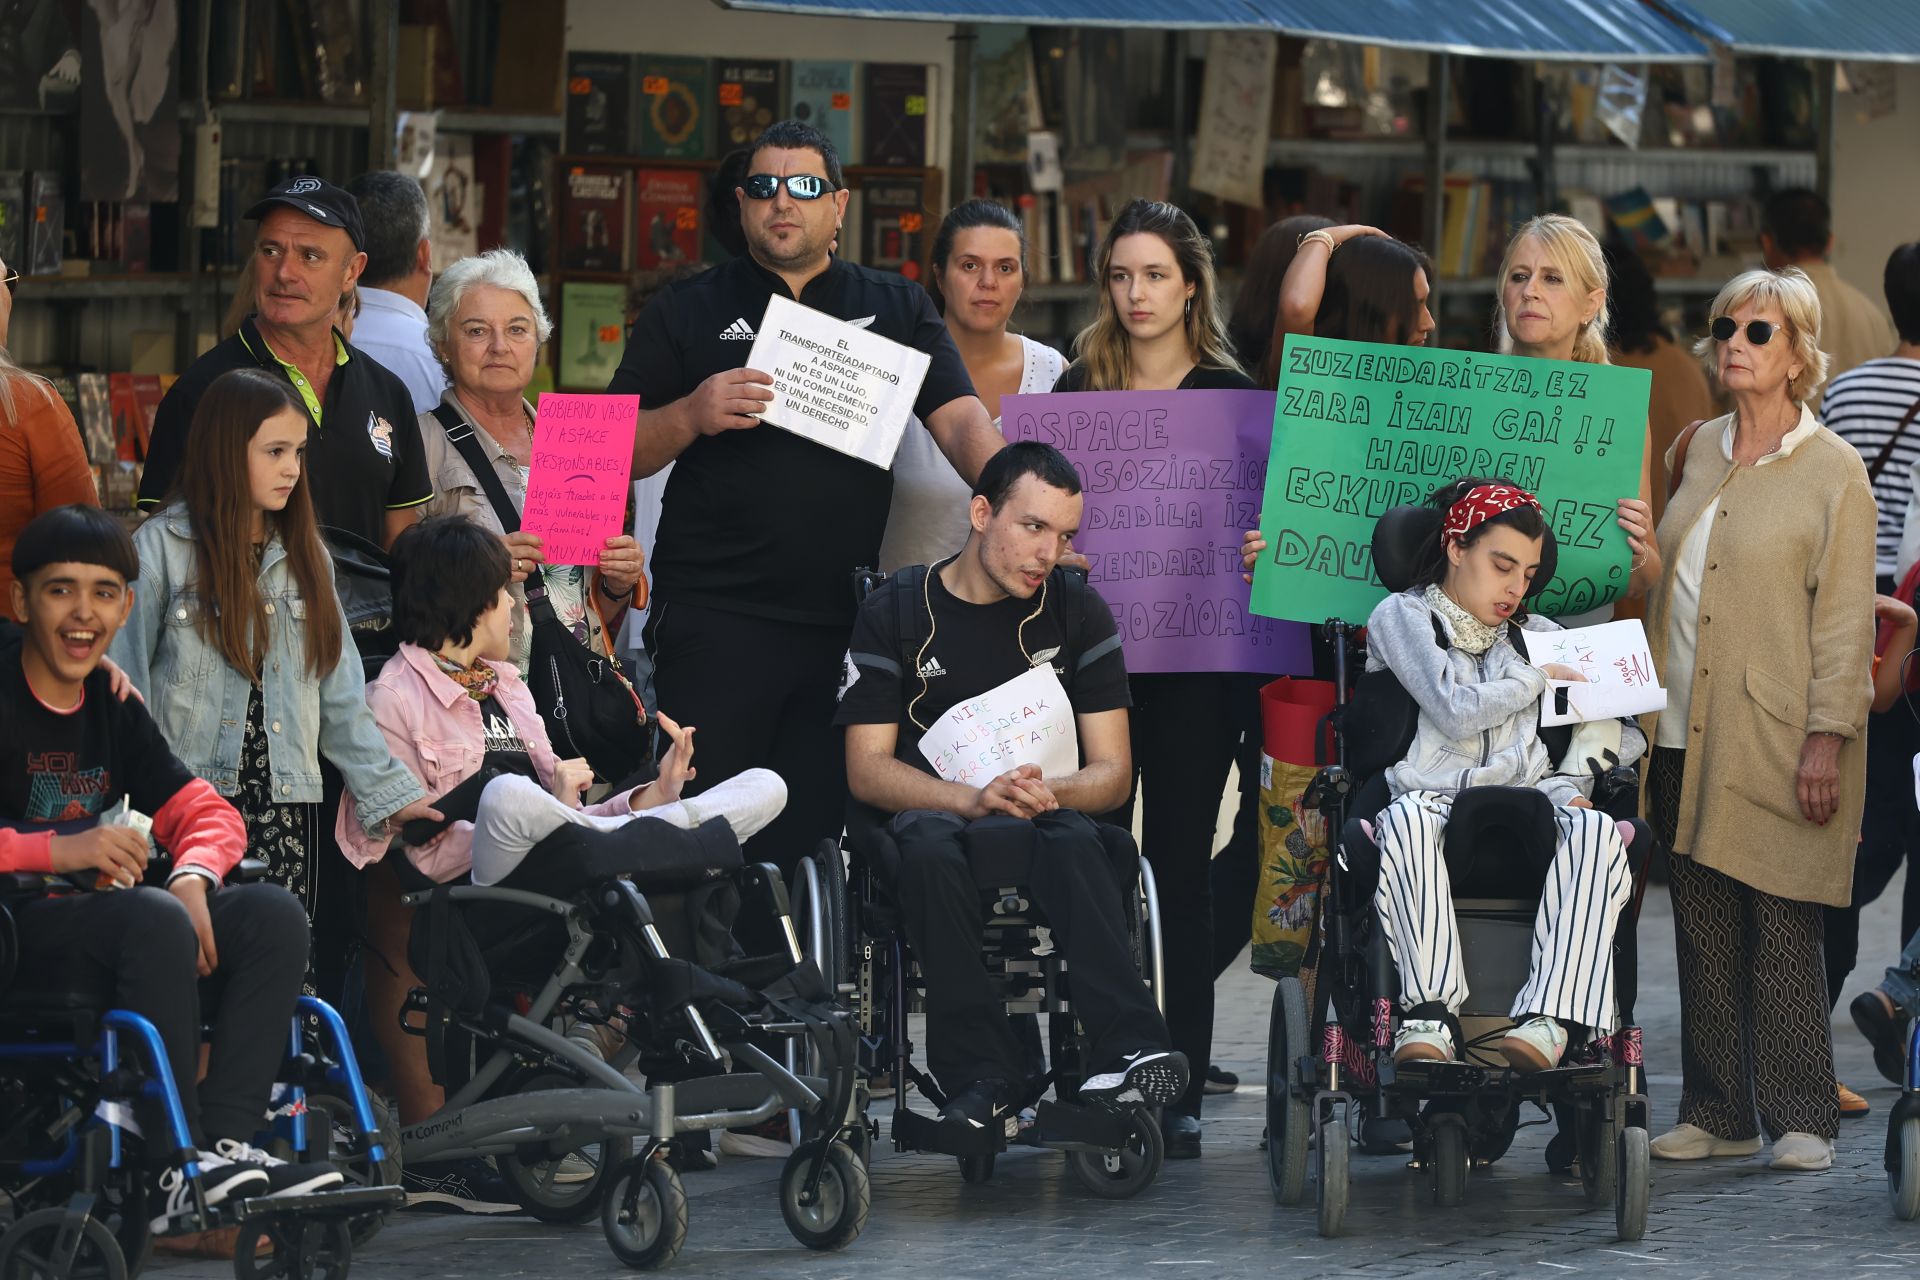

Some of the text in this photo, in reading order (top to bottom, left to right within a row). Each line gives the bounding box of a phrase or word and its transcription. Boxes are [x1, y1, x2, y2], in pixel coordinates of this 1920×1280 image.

[837, 339, 850, 351] EL
[792, 361, 867, 399] NO ES UN LUJO,
[811, 356, 859, 381] A ASPACE
[774, 367, 878, 415] NI UN COMPLEMENTO
[774, 381, 869, 427] ES UNA NECESIDAD,
[1282, 386, 1371, 426] ZARA
[540, 399, 635, 421] GOBIERNO VASCO
[785, 399, 850, 431] UN DERECHO
[545, 425, 610, 444] Y ASPACE
[1017, 408, 1169, 451] ASPACE
[535, 452, 628, 476] RESPONSABLES!
[1365, 437, 1546, 491] HAURREN
[1223, 493, 1257, 530] IZ
[549, 545, 600, 561] MUY MA
[1274, 529, 1386, 588] DAU
[916, 668, 947, 678] adidas
[951, 698, 991, 725] NIRE
[934, 698, 1050, 773] ESKUBIDEAK
[951, 721, 1066, 784] RRESPETATU
